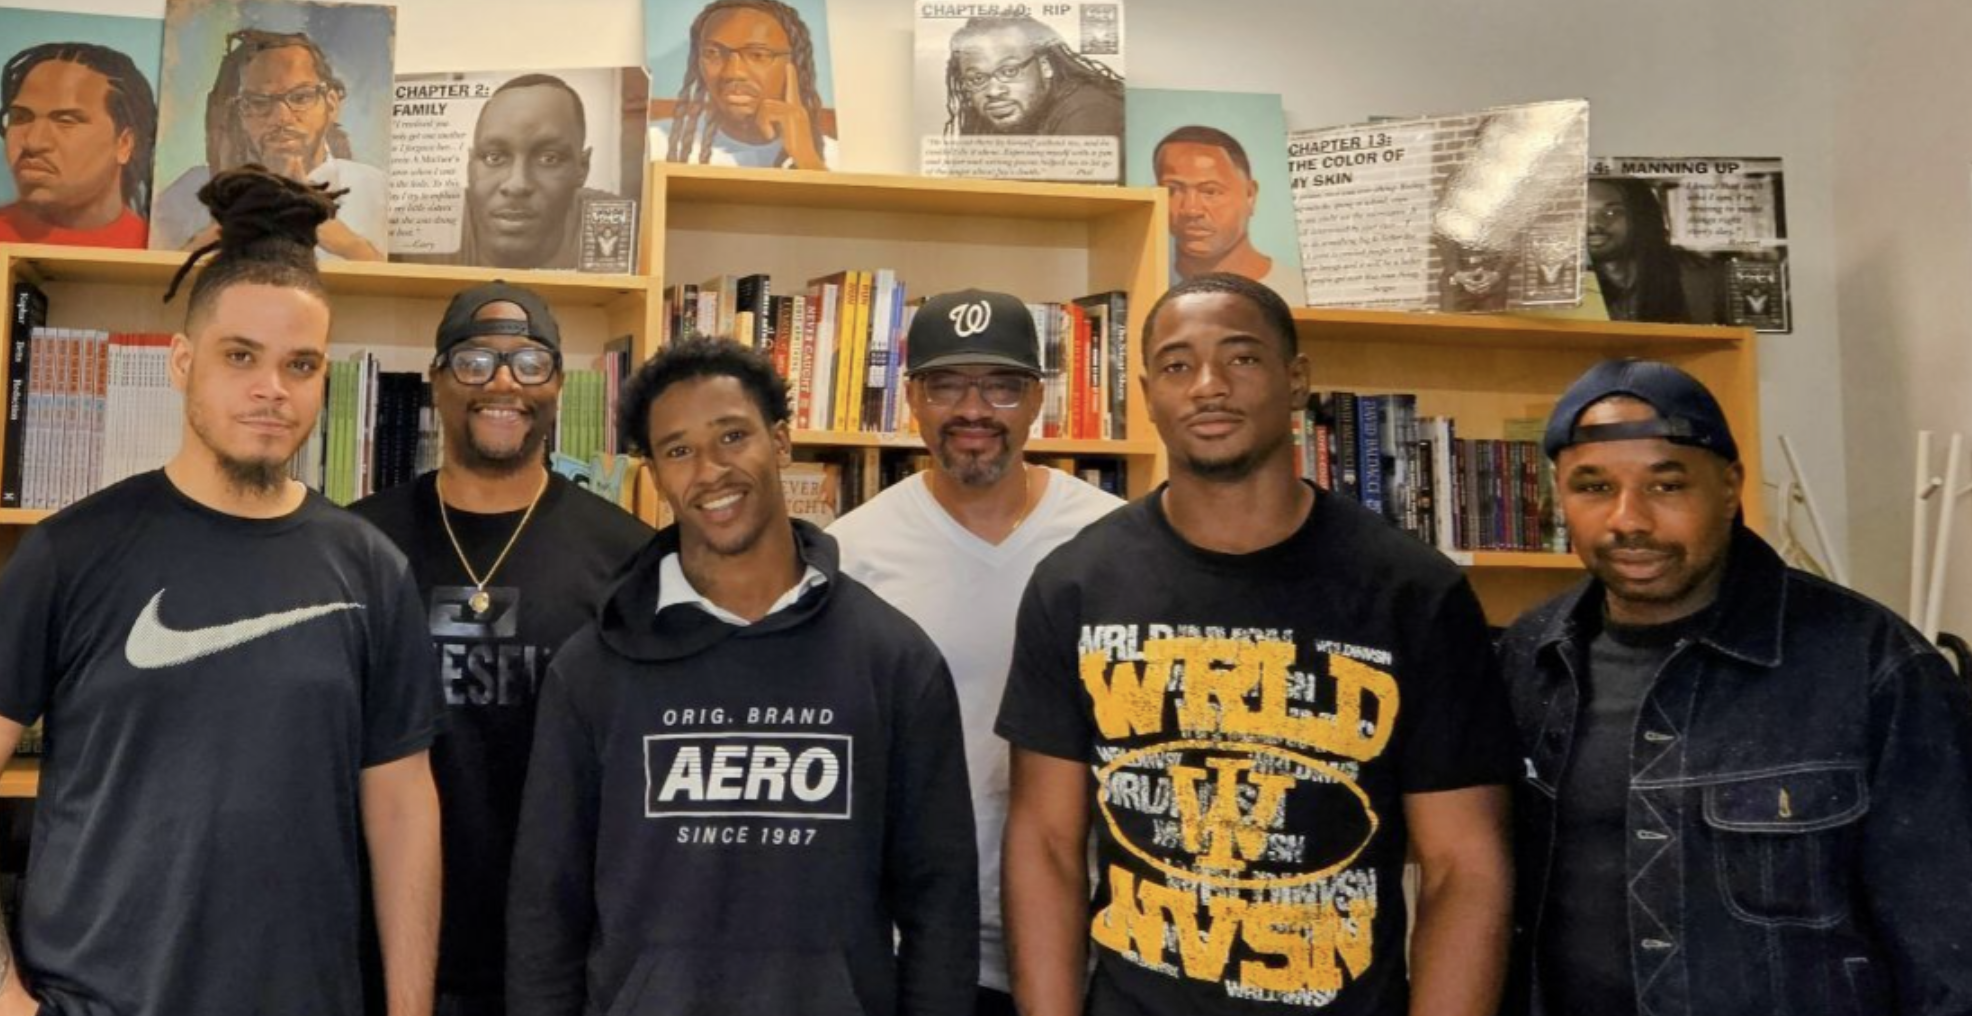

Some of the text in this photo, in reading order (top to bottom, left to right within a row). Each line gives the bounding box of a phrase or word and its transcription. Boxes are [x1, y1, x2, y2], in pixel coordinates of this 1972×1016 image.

[922, 3, 999, 15] CHAPTER
[1043, 4, 1071, 15] RIP
[395, 84, 489, 99] CHAPTER 2:
[392, 103, 447, 116] FAMILY
[1288, 133, 1392, 157] CHAPTER 13:
[1288, 148, 1405, 172] THE COLOR OF
[1622, 162, 1708, 174] MANNING
[1715, 162, 1739, 174] UP
[1313, 172, 1353, 187] SKIN
[948, 300, 991, 337] W
[799, 305, 816, 393] NEVER CAUGHT
[10, 379, 22, 420] Redaction
[1363, 400, 1378, 436] DAVID
[1365, 438, 1380, 493] BALDACCI
[1079, 636, 1400, 763] WRLD
[663, 707, 834, 726] ORIG. BRAND
[657, 745, 840, 802] AERO
[677, 826, 817, 845] SINCE 1987
